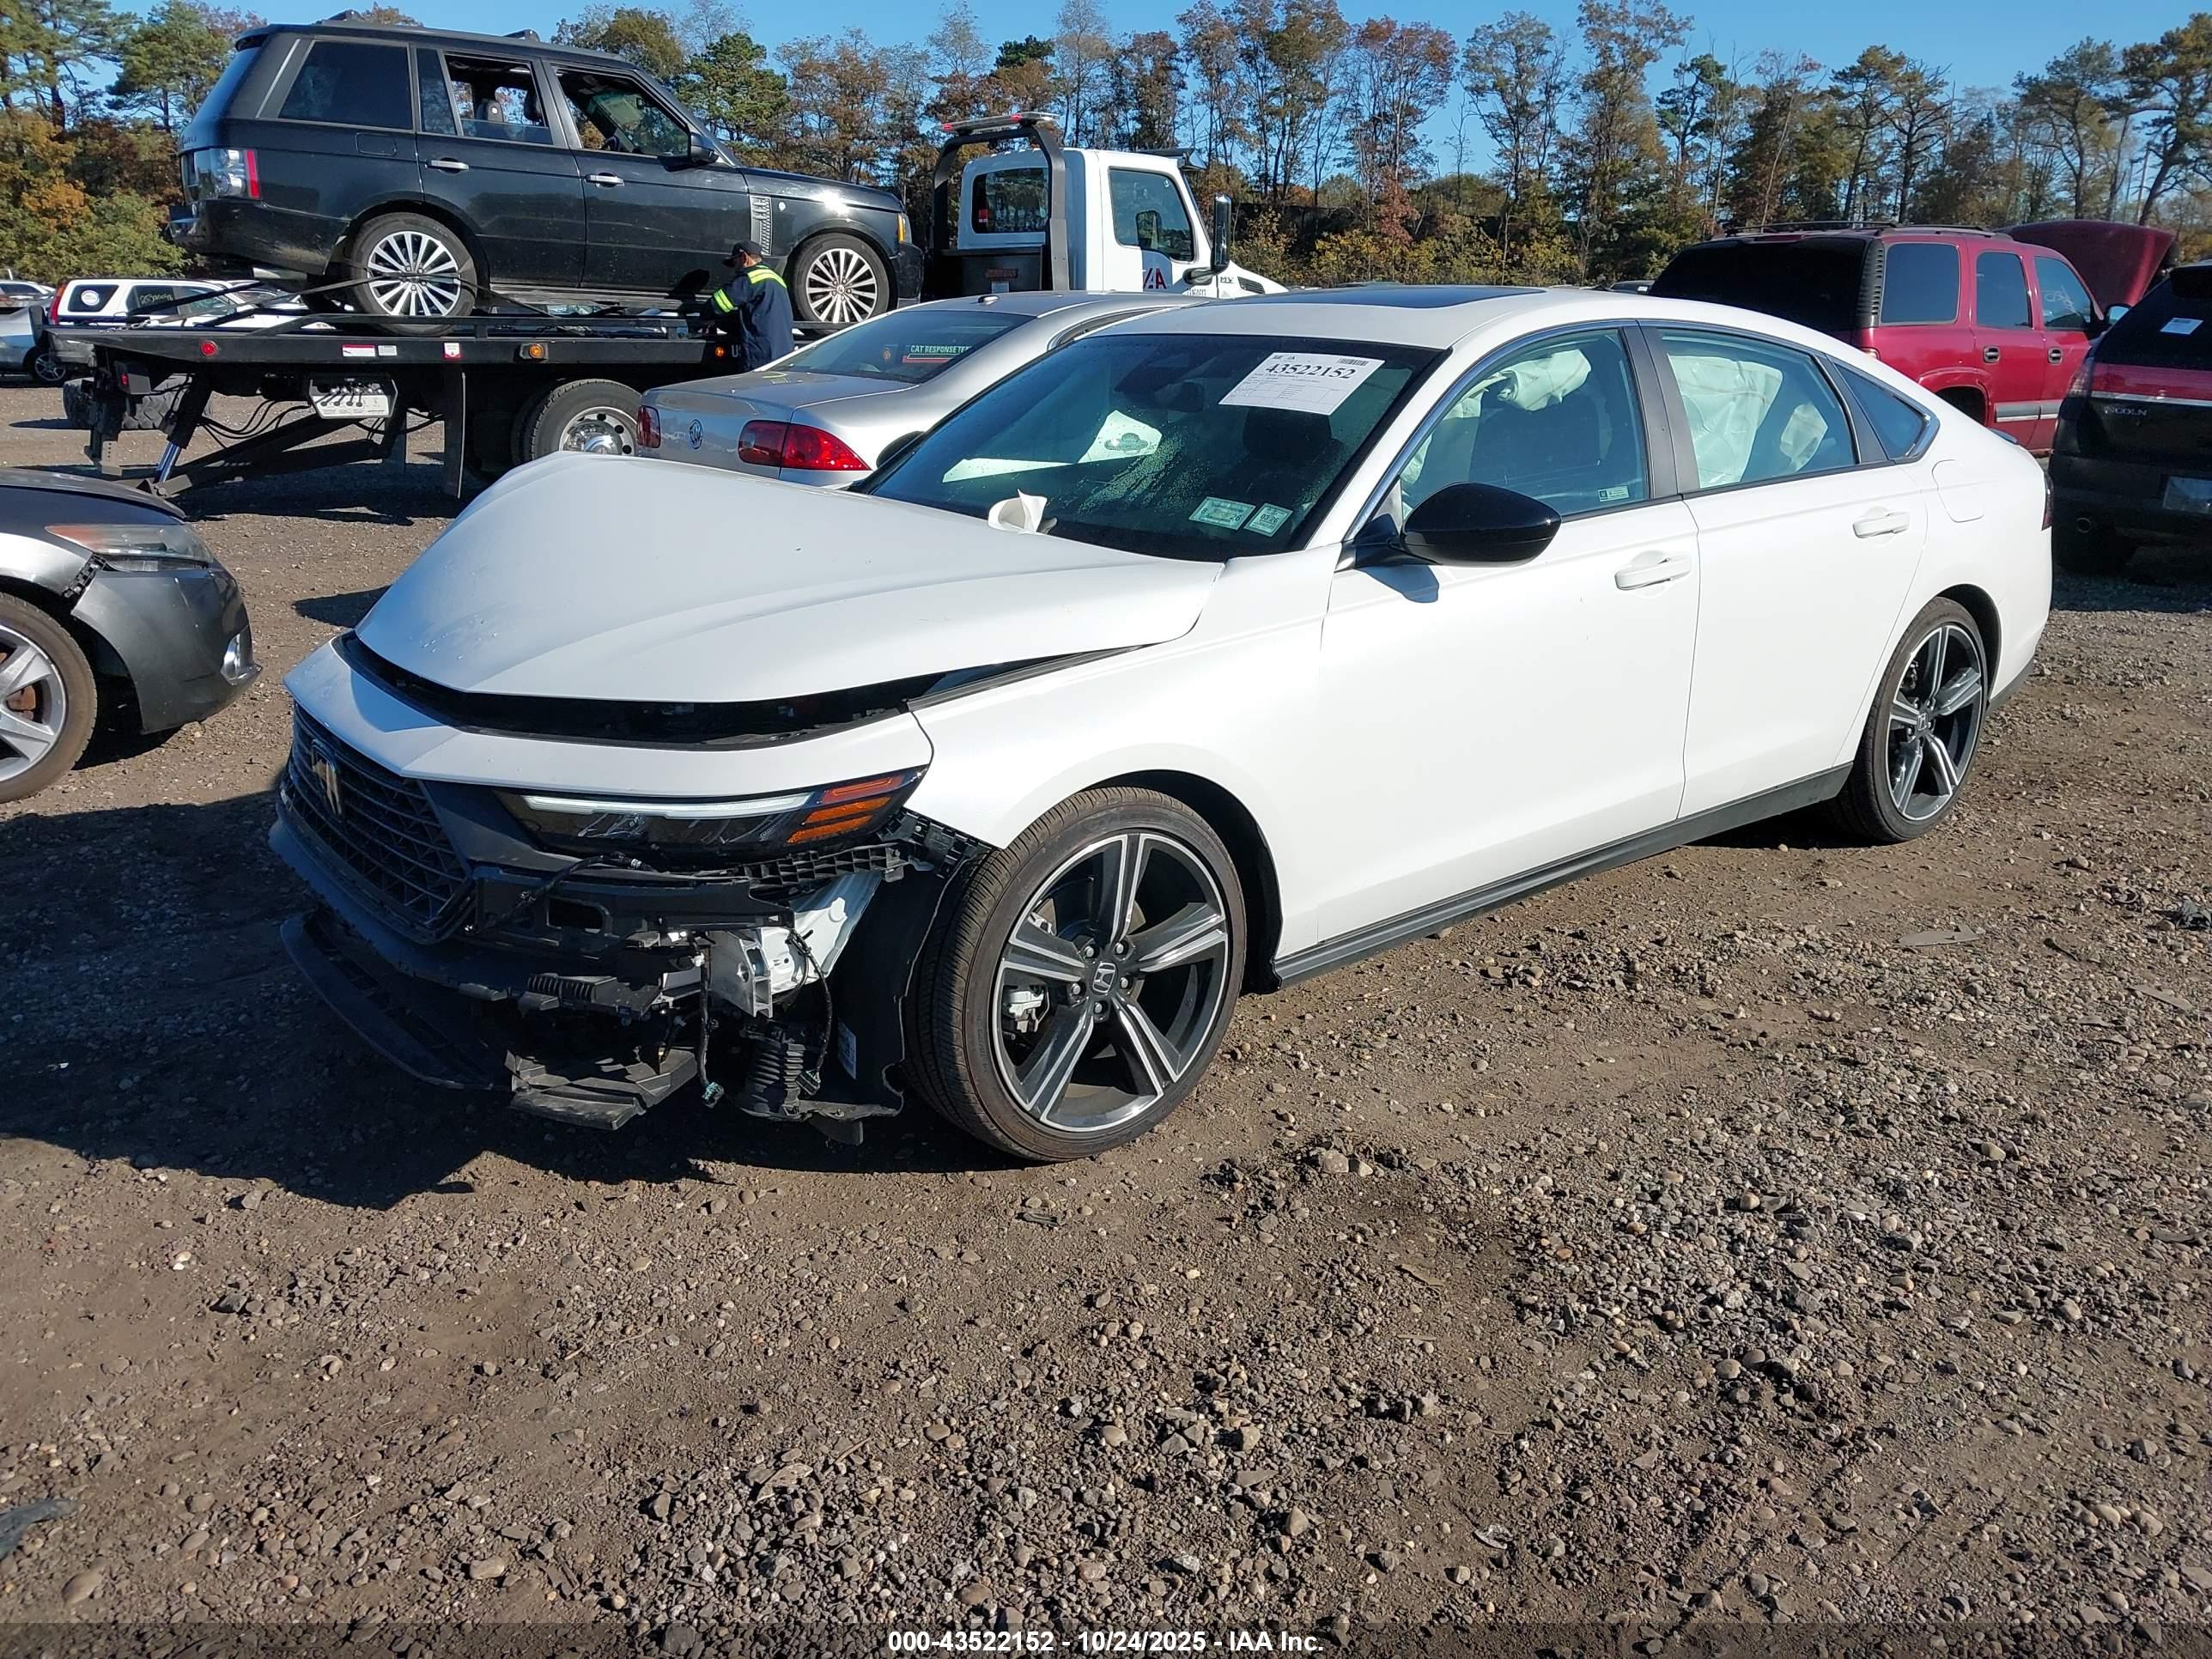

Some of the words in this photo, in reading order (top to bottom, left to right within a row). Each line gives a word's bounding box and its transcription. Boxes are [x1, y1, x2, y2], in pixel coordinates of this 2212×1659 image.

[910, 344, 924, 354] CAT
[925, 345, 957, 354] RESPONSE
[1265, 363, 1357, 380] 43522152
